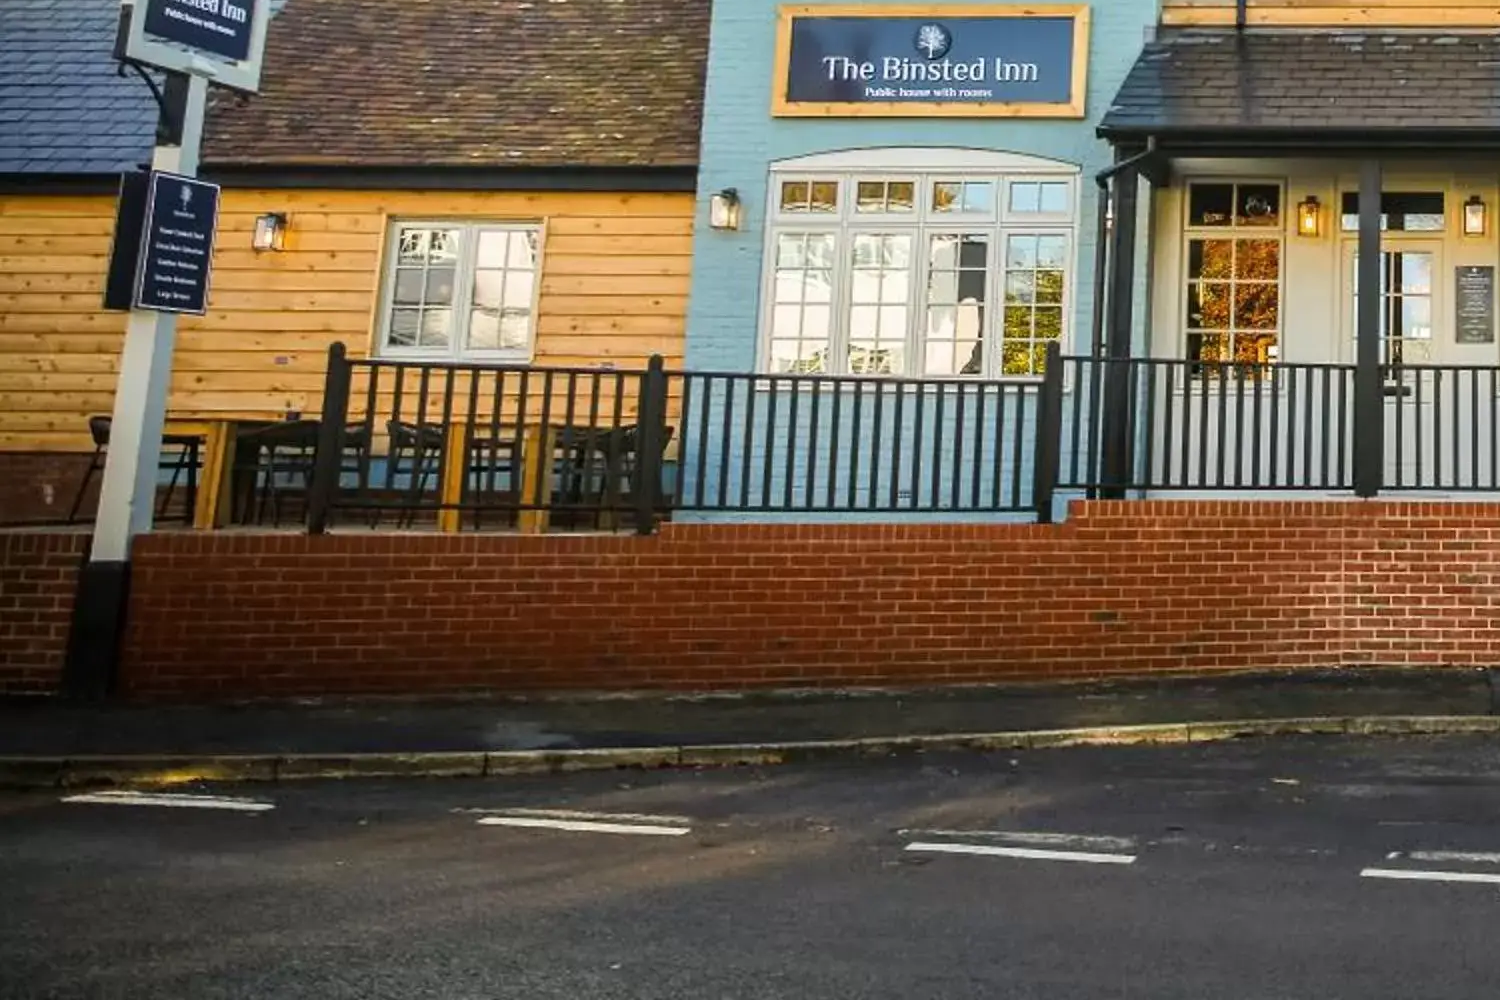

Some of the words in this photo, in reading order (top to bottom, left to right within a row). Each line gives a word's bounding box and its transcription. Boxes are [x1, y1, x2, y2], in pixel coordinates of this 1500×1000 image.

[822, 56, 875, 81] The
[882, 56, 985, 81] Binsted
[995, 56, 1038, 81] Inn
[865, 87, 897, 98] Public
[899, 87, 931, 98] house
[933, 87, 957, 98] with
[958, 87, 993, 98] rooms
